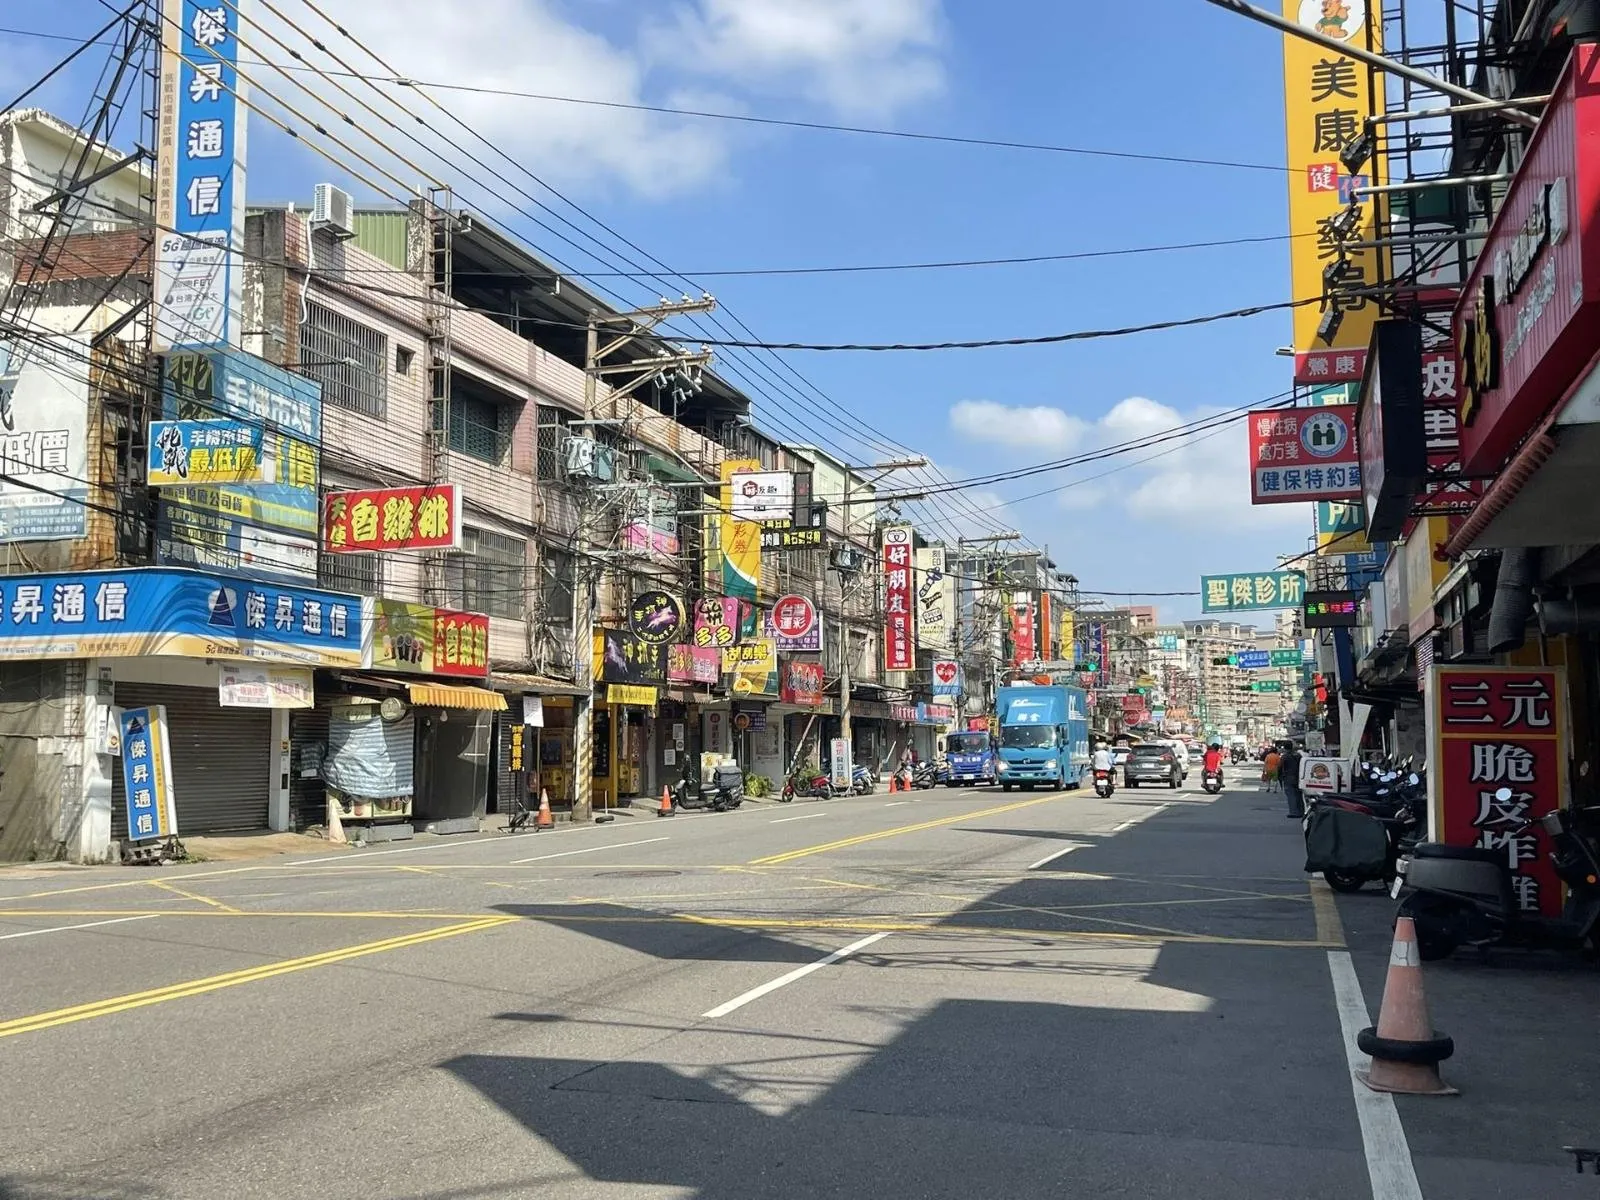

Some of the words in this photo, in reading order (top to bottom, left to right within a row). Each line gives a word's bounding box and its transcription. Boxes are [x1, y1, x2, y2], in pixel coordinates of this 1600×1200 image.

[187, 7, 226, 215] 傑昇通信
[1311, 56, 1360, 153] 美康
[1308, 356, 1367, 377] 鶯康
[191, 429, 252, 446] 手機市場
[1257, 417, 1298, 437] 慢性病
[155, 426, 187, 479] 挑戰
[188, 447, 257, 473] 最低價
[1258, 441, 1299, 461] 處方箋
[351, 494, 449, 542] 香雞排
[888, 547, 908, 614] 好朋友
[1207, 576, 1301, 606] 聖傑診所
[0, 583, 128, 625] 昇通信
[246, 592, 349, 638] 傑昇通信
[779, 618, 806, 630] 運彩
[781, 604, 806, 617] 台灣
[446, 619, 486, 668] 香雞排
[696, 626, 733, 647] 多多
[1447, 680, 1551, 727] 三元
[130, 739, 153, 834] 傑昇通信
